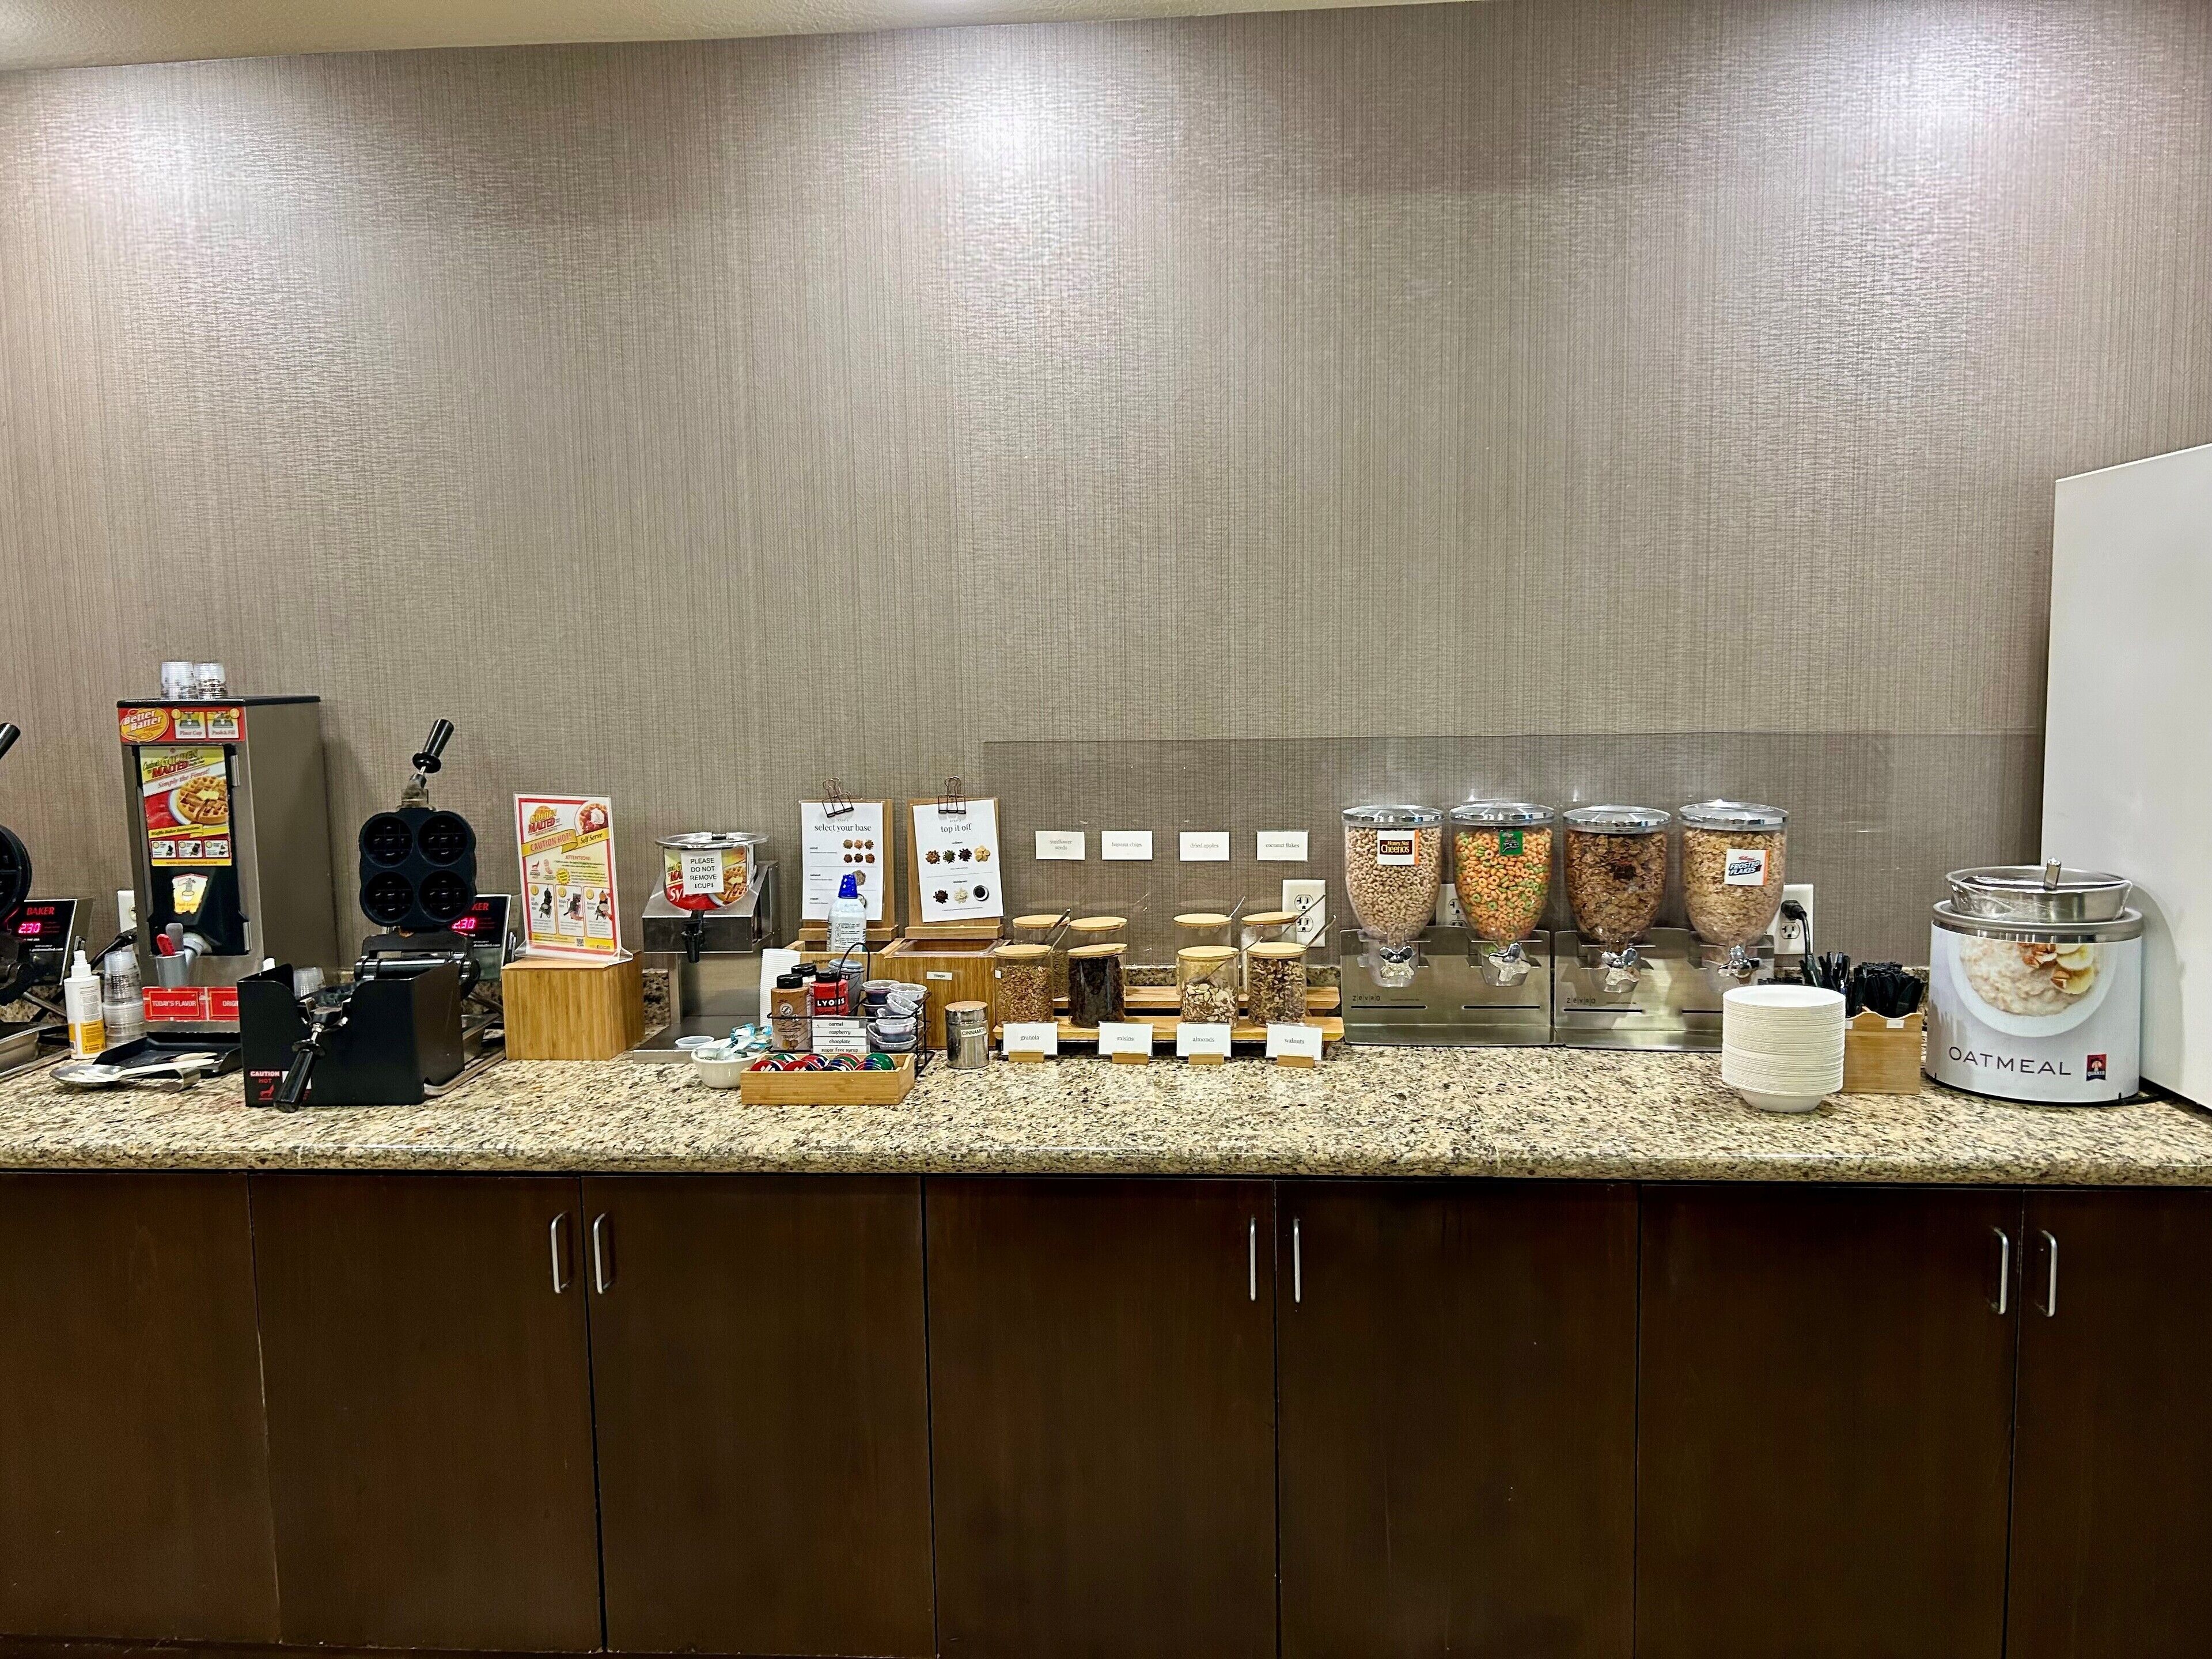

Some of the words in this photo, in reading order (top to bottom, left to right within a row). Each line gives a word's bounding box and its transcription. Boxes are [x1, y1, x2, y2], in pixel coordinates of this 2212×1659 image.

[122, 710, 157, 725] Better
[130, 716, 162, 731] Batter
[528, 817, 556, 834] MALTED
[814, 823, 835, 831] select
[941, 825, 953, 834] top
[961, 823, 972, 831] off
[580, 835, 589, 845] Self
[589, 833, 603, 841] Serve
[530, 838, 556, 852] CAUTION
[1381, 844, 1410, 853] Cheerios
[1730, 861, 1760, 870] FROSTED
[1730, 866, 1756, 875] FLAKES
[26, 907, 55, 915] BAKER
[472, 903, 489, 911] KER
[1949, 1046, 2071, 1075] OATMEAL
